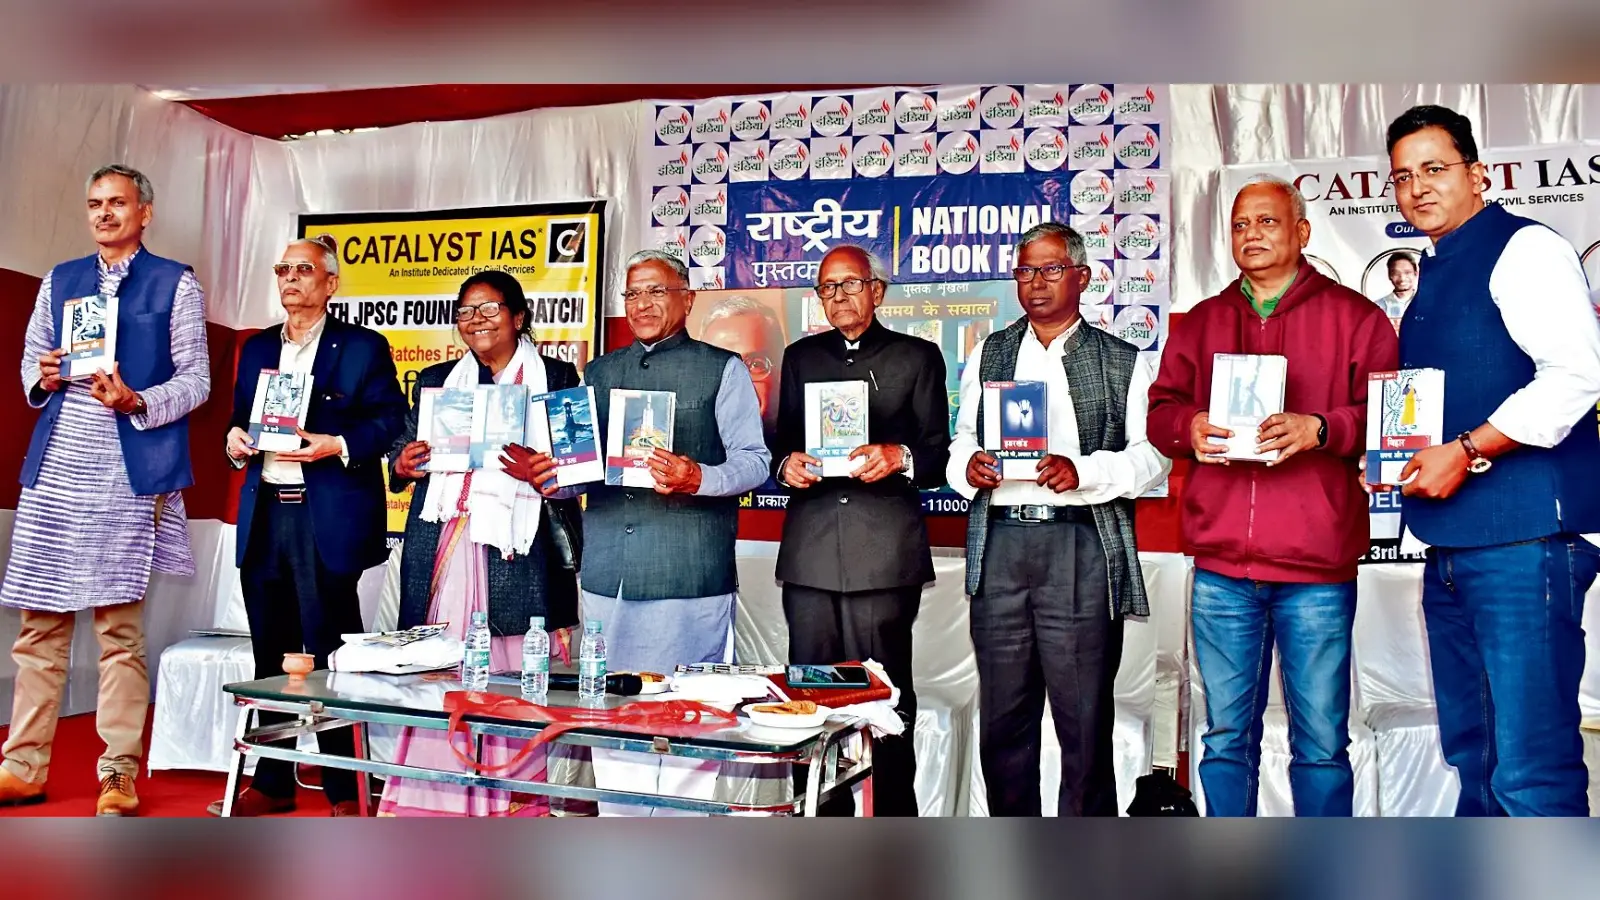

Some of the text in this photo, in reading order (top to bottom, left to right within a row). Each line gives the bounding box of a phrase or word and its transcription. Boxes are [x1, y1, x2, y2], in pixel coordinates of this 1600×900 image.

[1496, 197, 1526, 206] CIVIL
[1528, 193, 1584, 204] SERVICES
[745, 198, 882, 252] राष्ट्रीय
[344, 231, 482, 265] CATALYST
[912, 244, 992, 274] BOOK
[389, 268, 400, 277] An
[401, 267, 431, 276] Institute
[433, 265, 469, 276] Dedicated
[472, 265, 481, 275] for
[503, 264, 535, 275] Services
[903, 284, 932, 298] पुस्तक
[354, 301, 398, 326] JPSC
[403, 300, 458, 325] FOUN
[526, 297, 584, 323] BATCH
[879, 305, 914, 318] समय
[922, 301, 940, 316] के
[390, 345, 441, 362] Batches
[921, 498, 971, 512] -11000
[1370, 545, 1397, 560] 3rd
